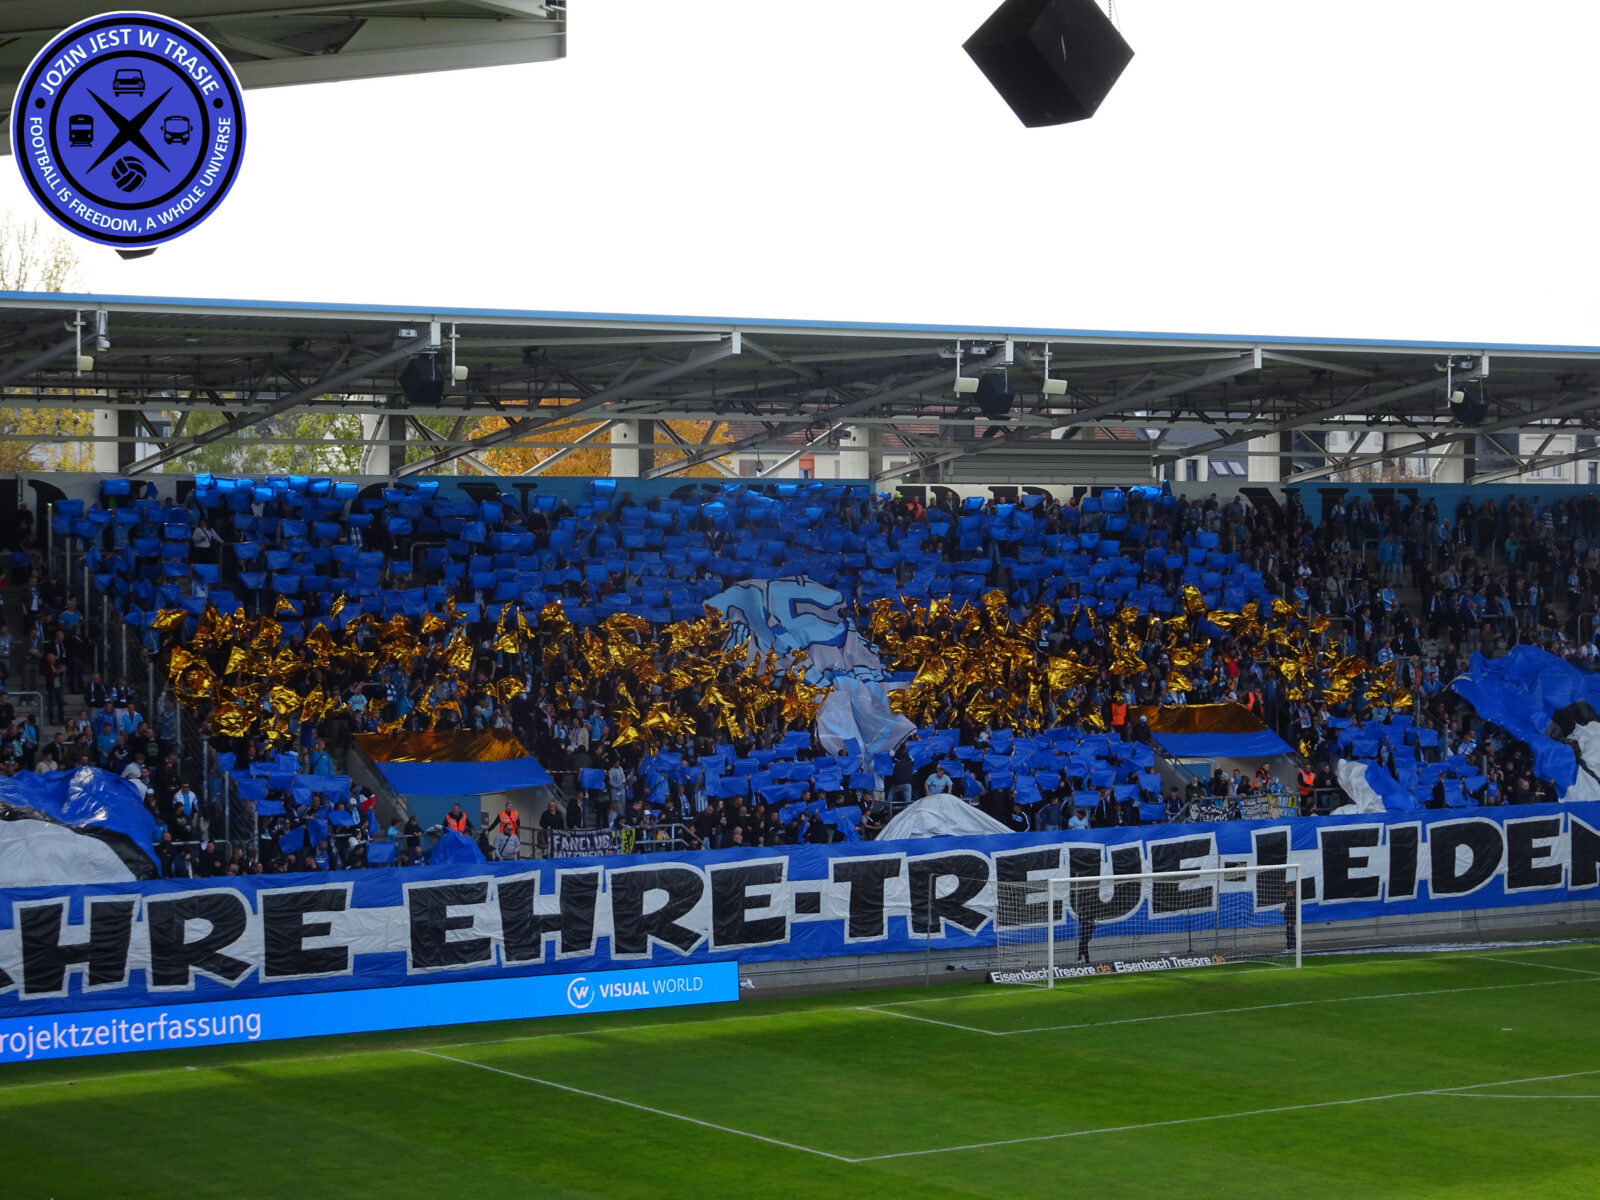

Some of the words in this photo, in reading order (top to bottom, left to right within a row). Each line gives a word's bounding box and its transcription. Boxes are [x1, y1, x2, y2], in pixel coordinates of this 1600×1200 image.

[553, 835, 610, 851] FANCLUB
[0, 882, 354, 1000] HRE
[1114, 957, 1172, 973] Eisenbach
[990, 967, 1050, 983] Eisenbach
[600, 980, 650, 998] VISUAL
[652, 976, 703, 994] WORLD
